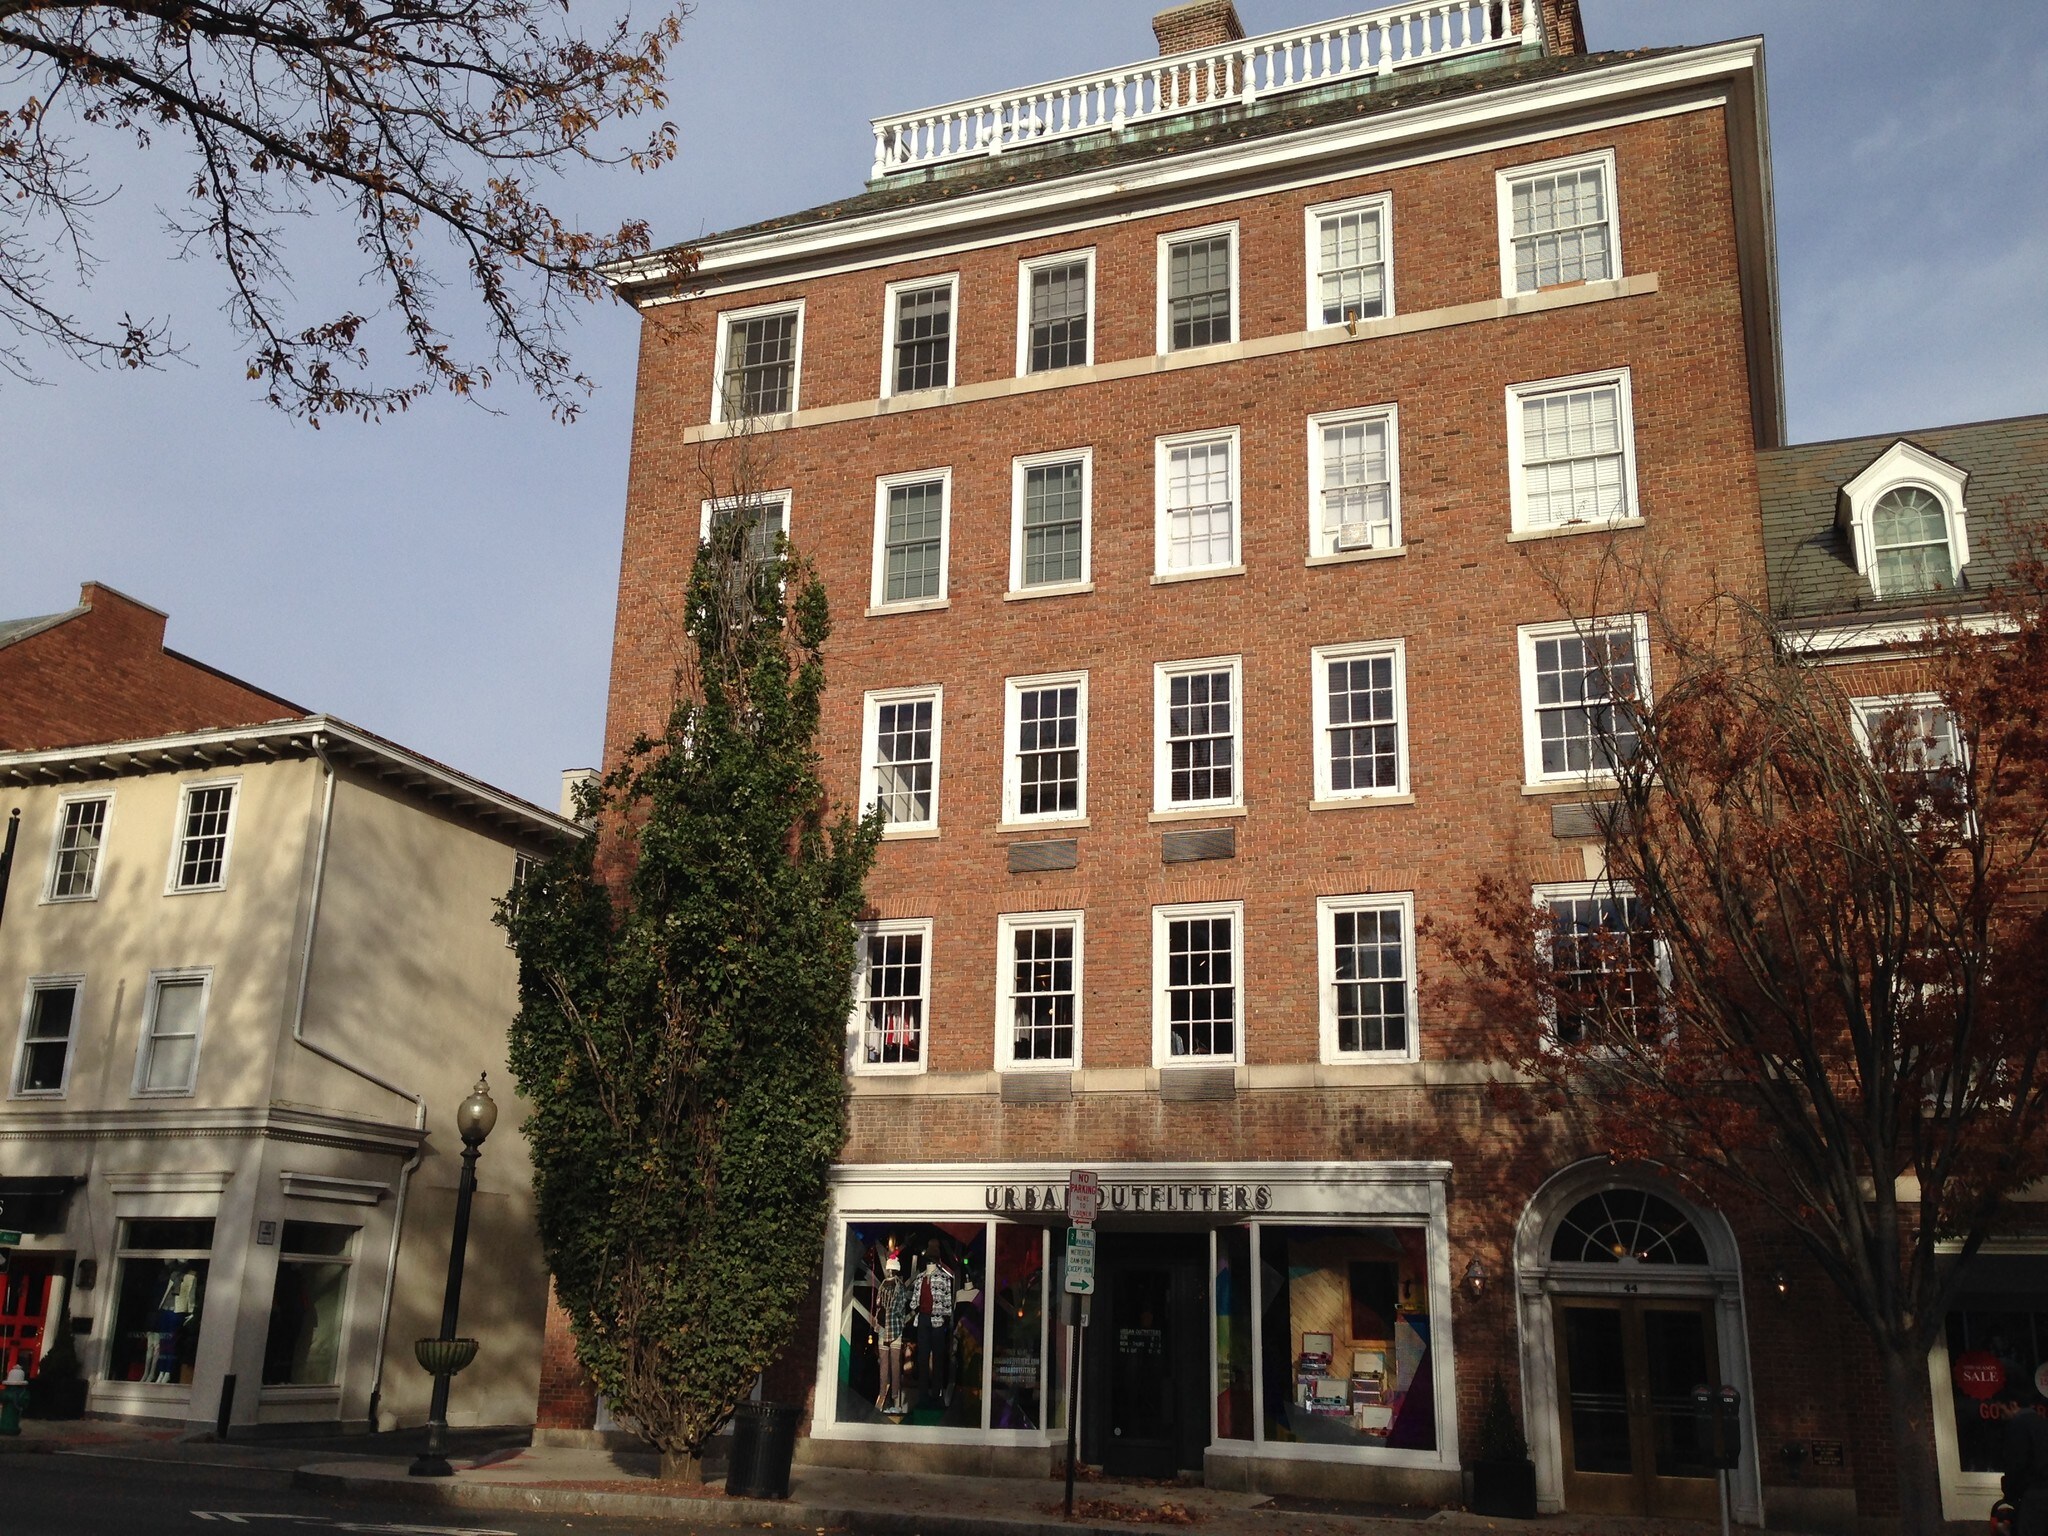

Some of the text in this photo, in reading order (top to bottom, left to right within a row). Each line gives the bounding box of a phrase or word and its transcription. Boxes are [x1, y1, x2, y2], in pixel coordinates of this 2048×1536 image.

[1078, 1174, 1090, 1183] NO
[1070, 1184, 1097, 1194] PARKING
[985, 1185, 1070, 1210] URBA
[1624, 1284, 1638, 1292] 44
[1963, 1371, 1999, 1382] SALE
